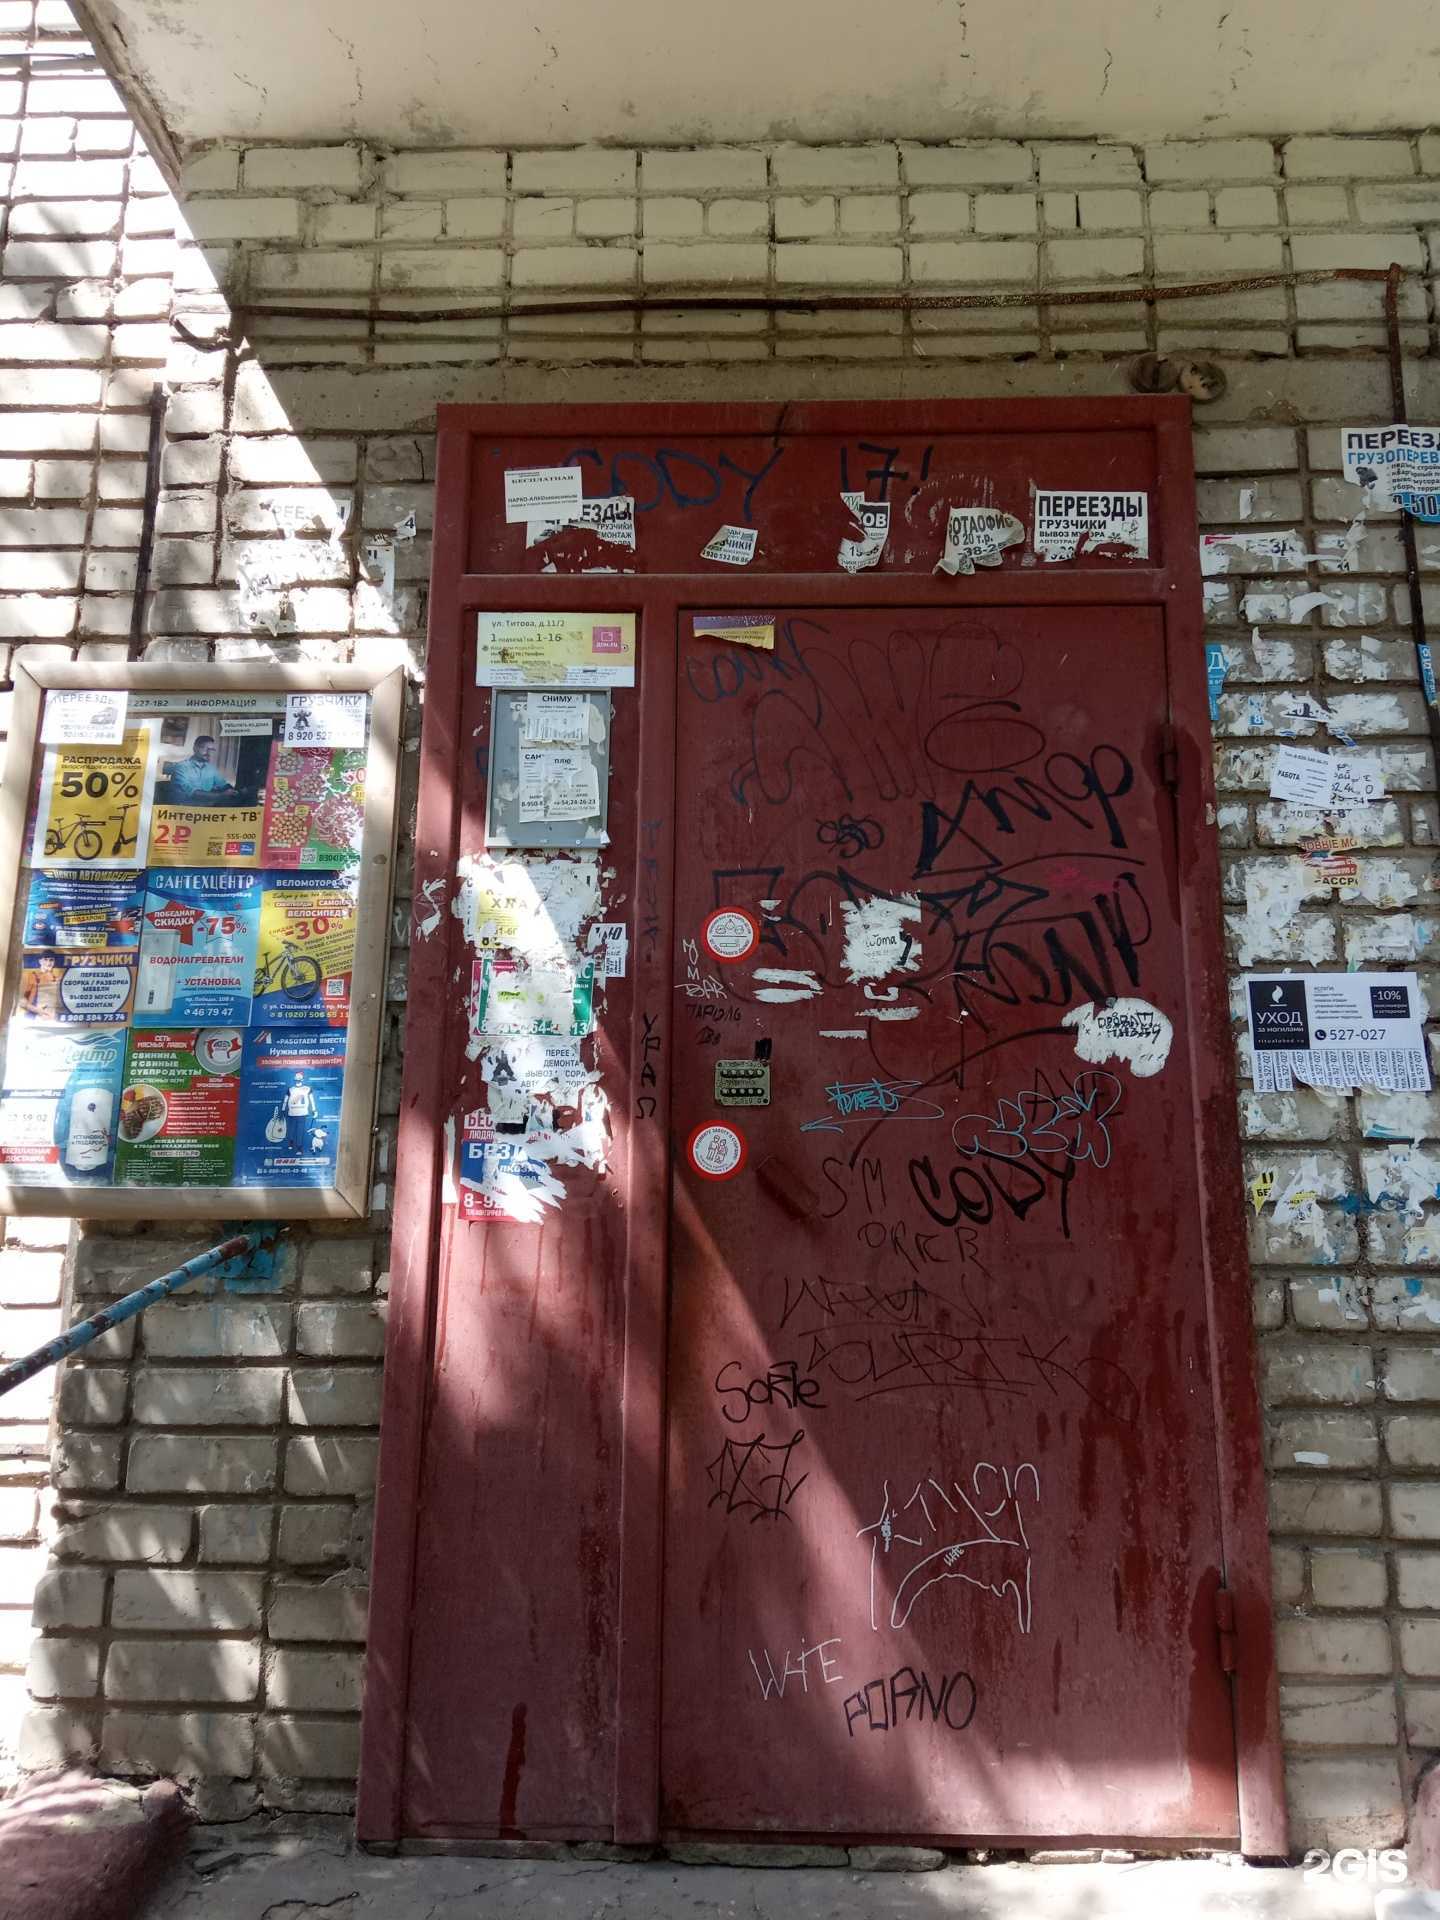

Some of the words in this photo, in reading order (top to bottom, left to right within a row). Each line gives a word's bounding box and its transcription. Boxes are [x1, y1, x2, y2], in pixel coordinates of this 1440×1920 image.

[1038, 496, 1143, 521] ПЕРЕЕЗДЫ
[1038, 519, 1107, 530] ГРУЗЧИКИ
[536, 633, 562, 642] 1-16
[185, 698, 257, 709] ИНФОРМАЦИЯ
[291, 695, 361, 707] ГРУЗЧИКИ
[542, 694, 573, 703] СНИМУ
[288, 731, 293, 741] 8
[295, 731, 314, 741] 920
[62, 755, 141, 765] РАСПРОДАЖА
[60, 771, 139, 798] 50%
[157, 808, 225, 824] Интернет
[241, 810, 258, 822] ТВ
[155, 874, 255, 889] САНТЕХЦЕНТР
[154, 910, 196, 918] ПОБЕДНАЯ
[154, 918, 195, 927] СКИДКА
[63, 954, 133, 966] ГРУЗЧИКИ
[149, 955, 244, 965] ВОДОНАГРЕВАТЕЛИ
[184, 978, 241, 986] УСТАНОВКА
[1372, 990, 1401, 1001] -10%
[207, 1008, 220, 1016] 79
[221, 1008, 234, 1016] 47
[1256, 1011, 1304, 1026] УХОД
[1329, 1029, 1387, 1041] 527-027
[269, 1047, 298, 1057] Нужна
[298, 1047, 335, 1056] помощь?
[545, 1049, 575, 1057] ПЕРЕЕ
[544, 1059, 580, 1067] ДЕМОНТА
